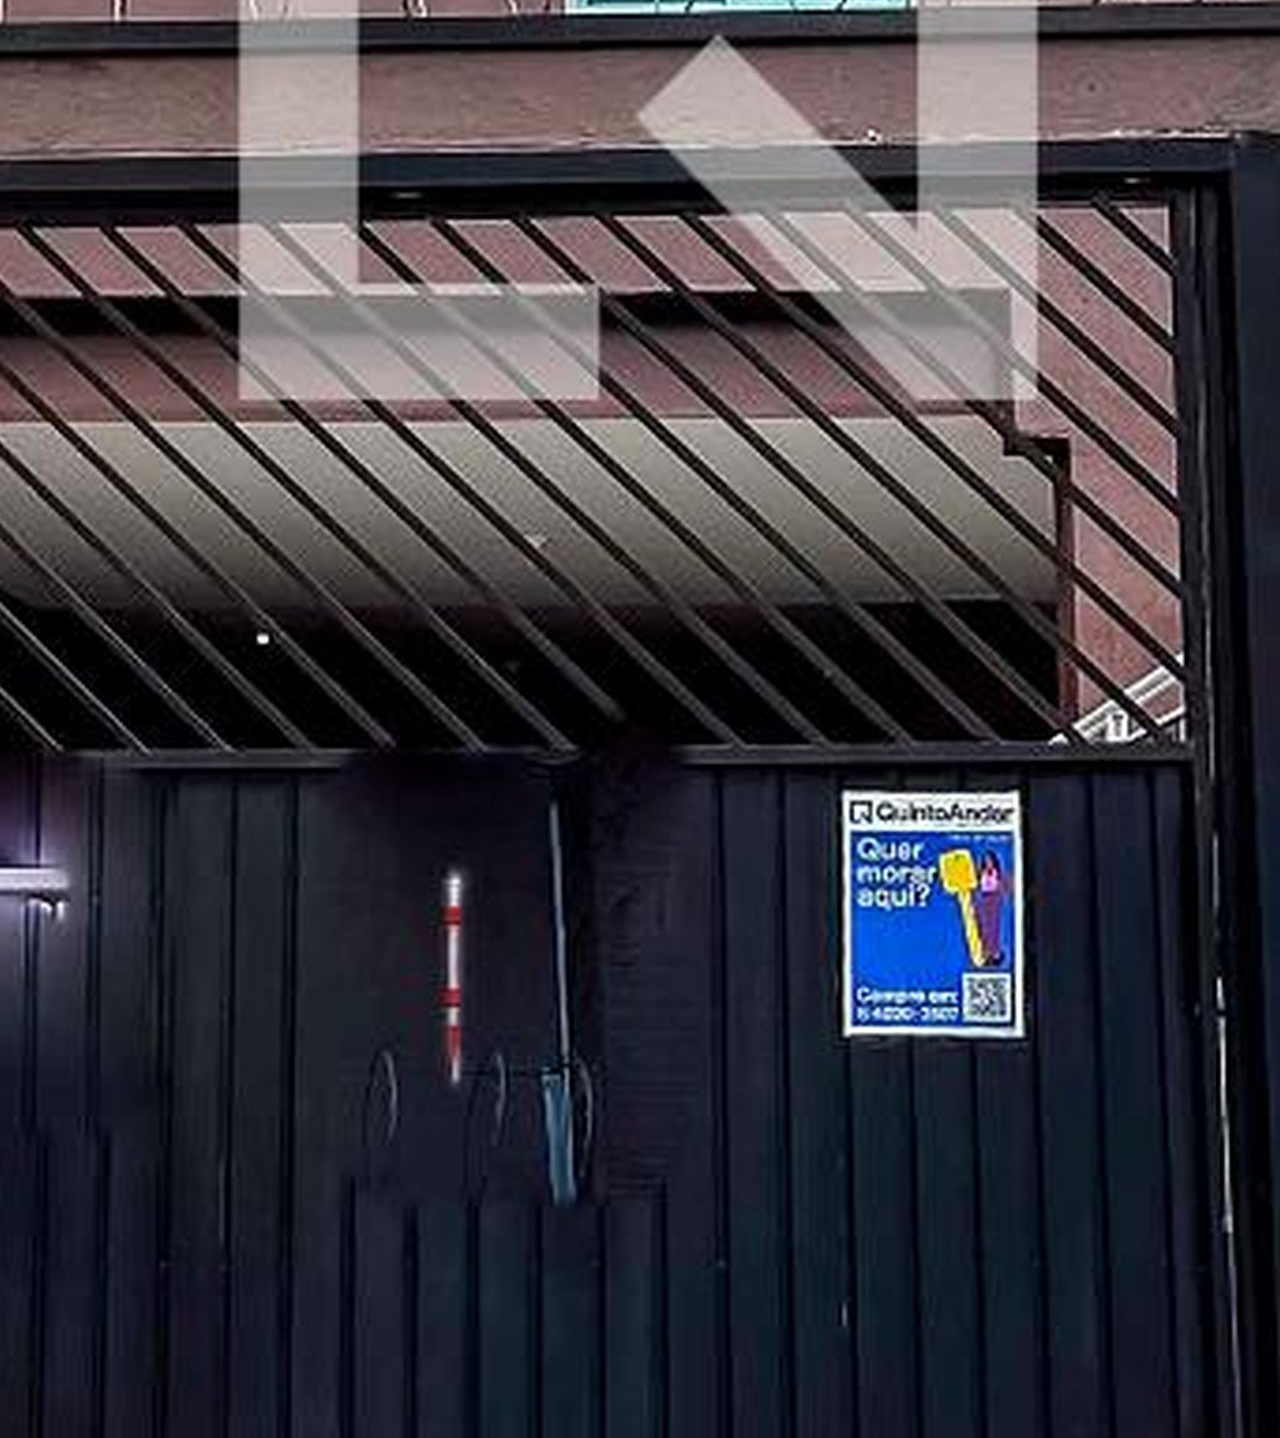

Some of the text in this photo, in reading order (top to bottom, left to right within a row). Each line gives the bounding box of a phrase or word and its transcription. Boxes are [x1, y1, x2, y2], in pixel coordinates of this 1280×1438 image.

[856, 837, 925, 861] Quer
[856, 865, 937, 884] morar
[856, 883, 931, 911] aqui?
